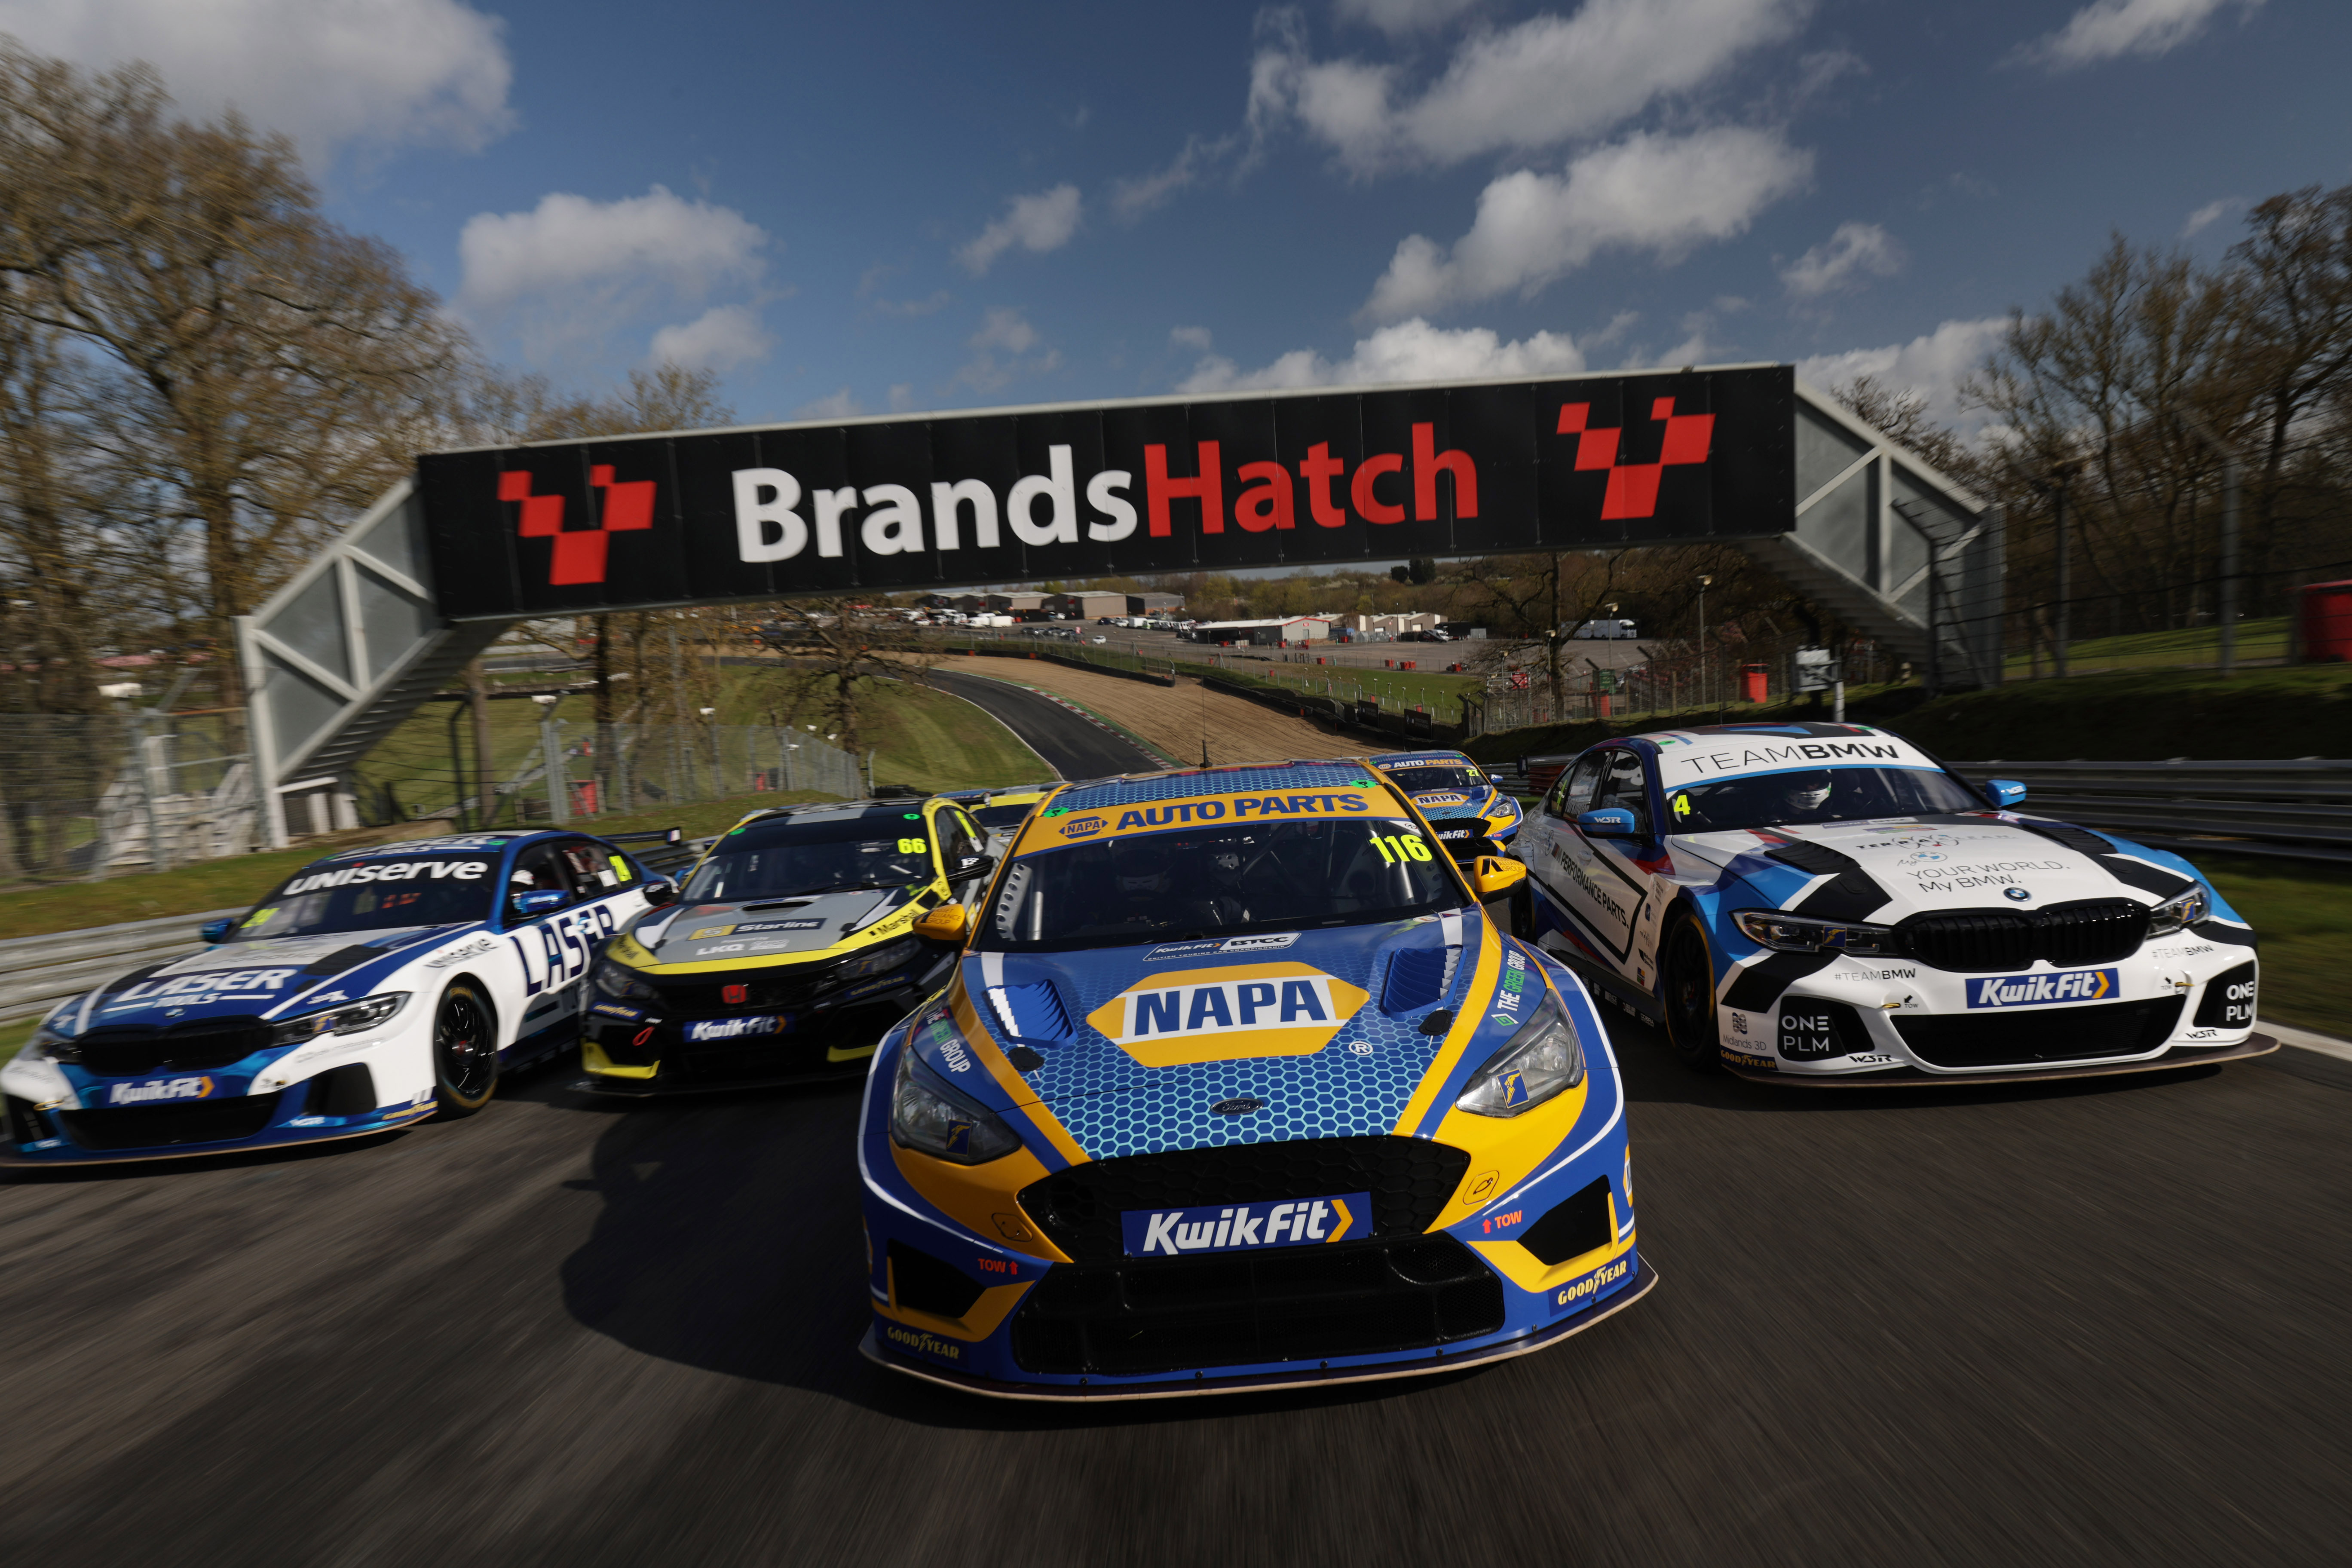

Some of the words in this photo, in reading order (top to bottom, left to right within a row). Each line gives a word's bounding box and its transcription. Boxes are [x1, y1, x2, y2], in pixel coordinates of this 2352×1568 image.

[732, 422, 1478, 564] BrandsHatch
[1394, 760, 1424, 768] AUTO
[1418, 795, 1461, 804] NAPA
[1673, 795, 1690, 815] 4
[1066, 820, 1101, 834] NAPA
[1116, 801, 1226, 831] AUTO
[1234, 793, 1369, 817] PARTS
[897, 838, 927, 854] 66
[1369, 834, 1433, 863] 116
[1560, 851, 1602, 905] PERFORMANCE
[1906, 863, 1971, 880] YOUR
[1976, 861, 2070, 873] WORLD.
[1918, 881, 1953, 893] My
[1954, 874, 2021, 888] BMW.
[735, 921, 820, 932] Starline
[695, 944, 745, 956] LKQ
[1230, 937, 1289, 946] BTCC
[1507, 950, 1526, 971] GROUP
[1503, 968, 1525, 993] GREEN
[1834, 968, 1916, 982] #TEAMBMW
[113, 968, 298, 1003] LASER
[2226, 981, 2254, 1001] ONE
[1134, 980, 1328, 1036] NAPA
[1497, 989, 1521, 1011] THE
[1781, 1015, 1830, 1032] ONE
[1723, 1034, 1752, 1049] Midlands
[1754, 1040, 1767, 1050] 3D
[1783, 1035, 1830, 1052] PLM
[2186, 1029, 2219, 1040] WSR
[939, 1038, 971, 1073] GROUP
[1848, 1054, 1893, 1063] WSR
[1222, 1101, 1251, 1112] Ford
[1494, 1210, 1522, 1229] TOW
[977, 1258, 1006, 1273] TOW
